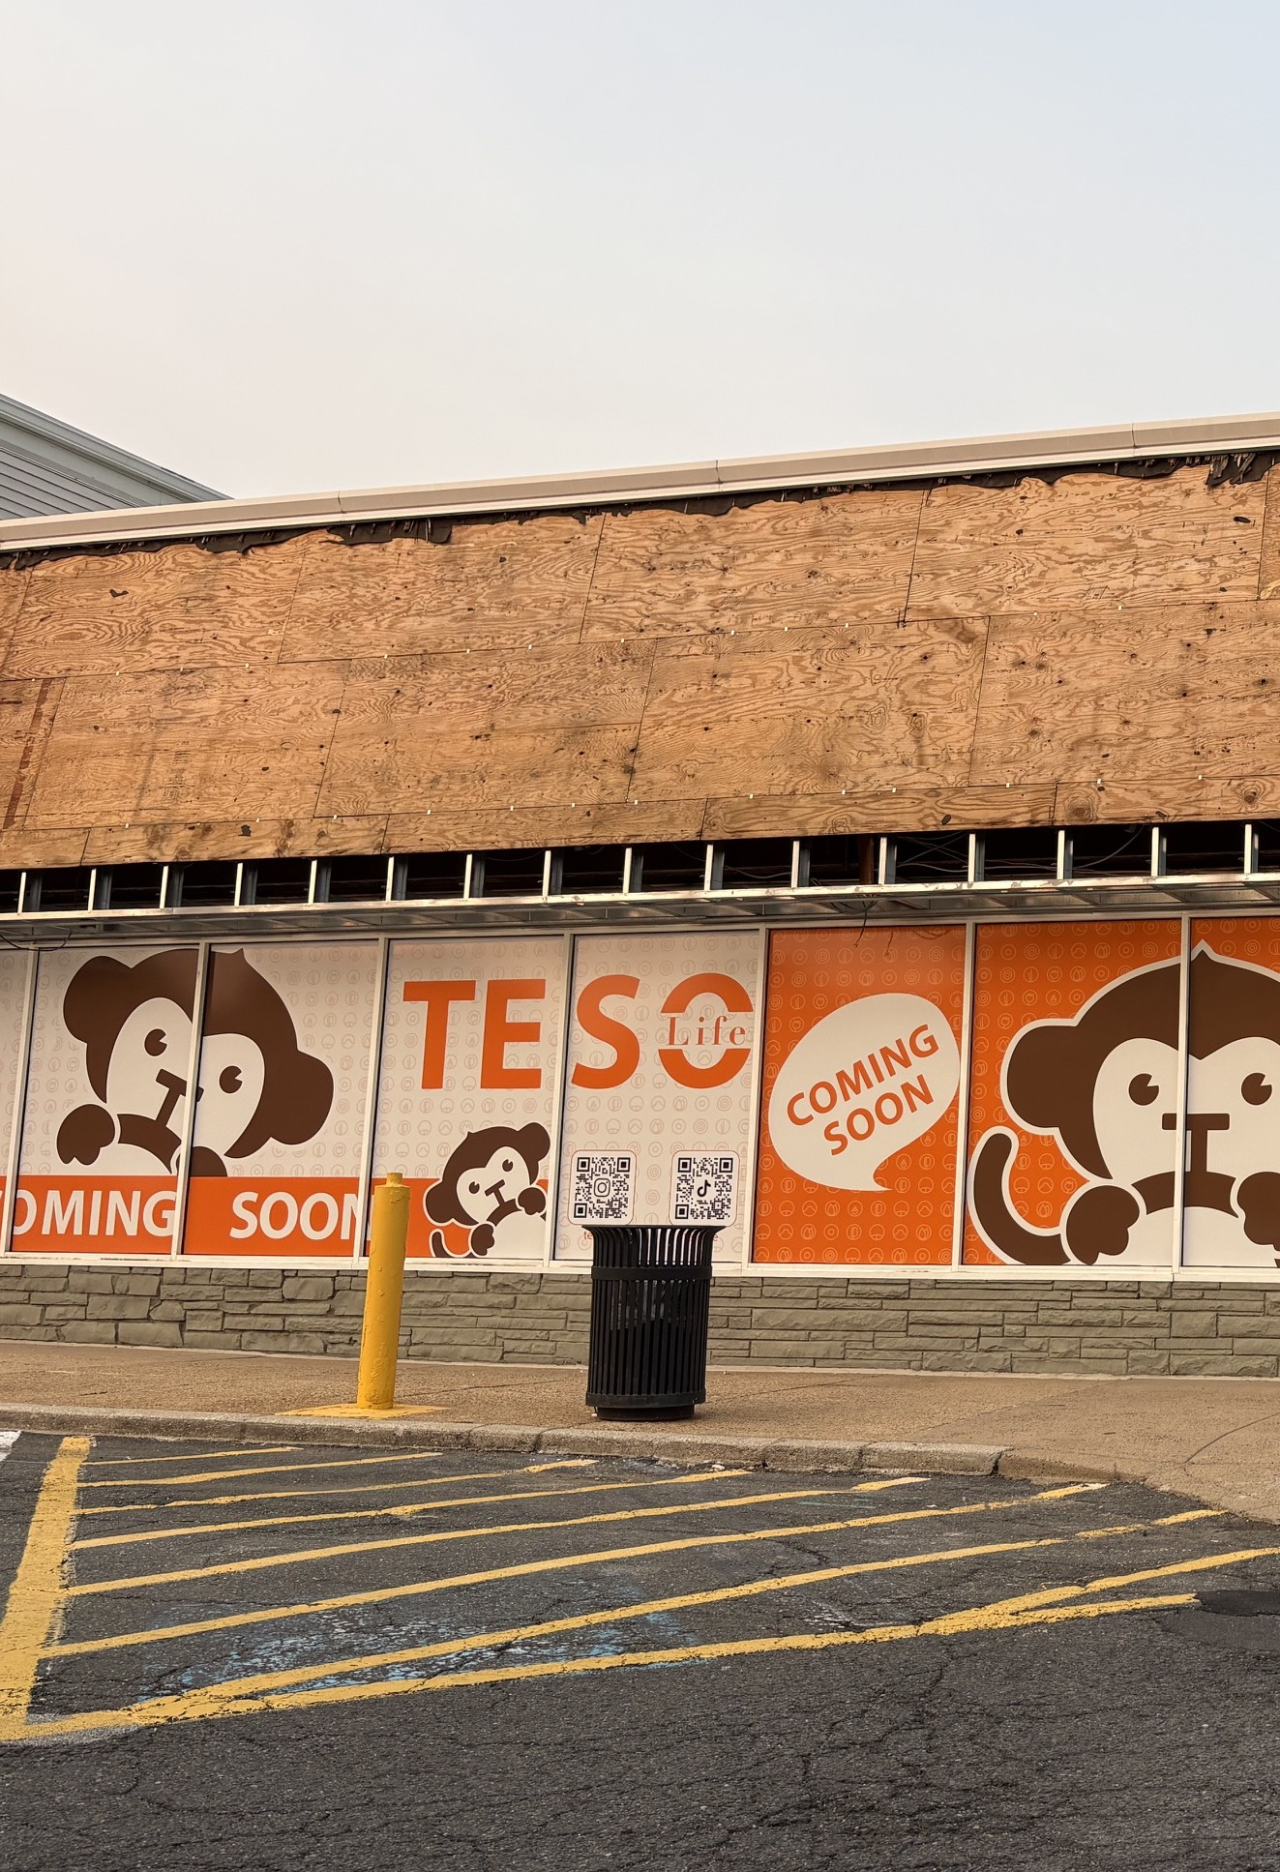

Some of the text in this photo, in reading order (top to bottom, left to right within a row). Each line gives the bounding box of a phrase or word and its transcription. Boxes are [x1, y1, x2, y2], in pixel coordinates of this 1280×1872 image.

[402, 972, 754, 1090] TESO Life
[786, 1023, 940, 1127] COMING
[823, 1074, 935, 1156] SOON
[0, 1189, 177, 1237] OMING
